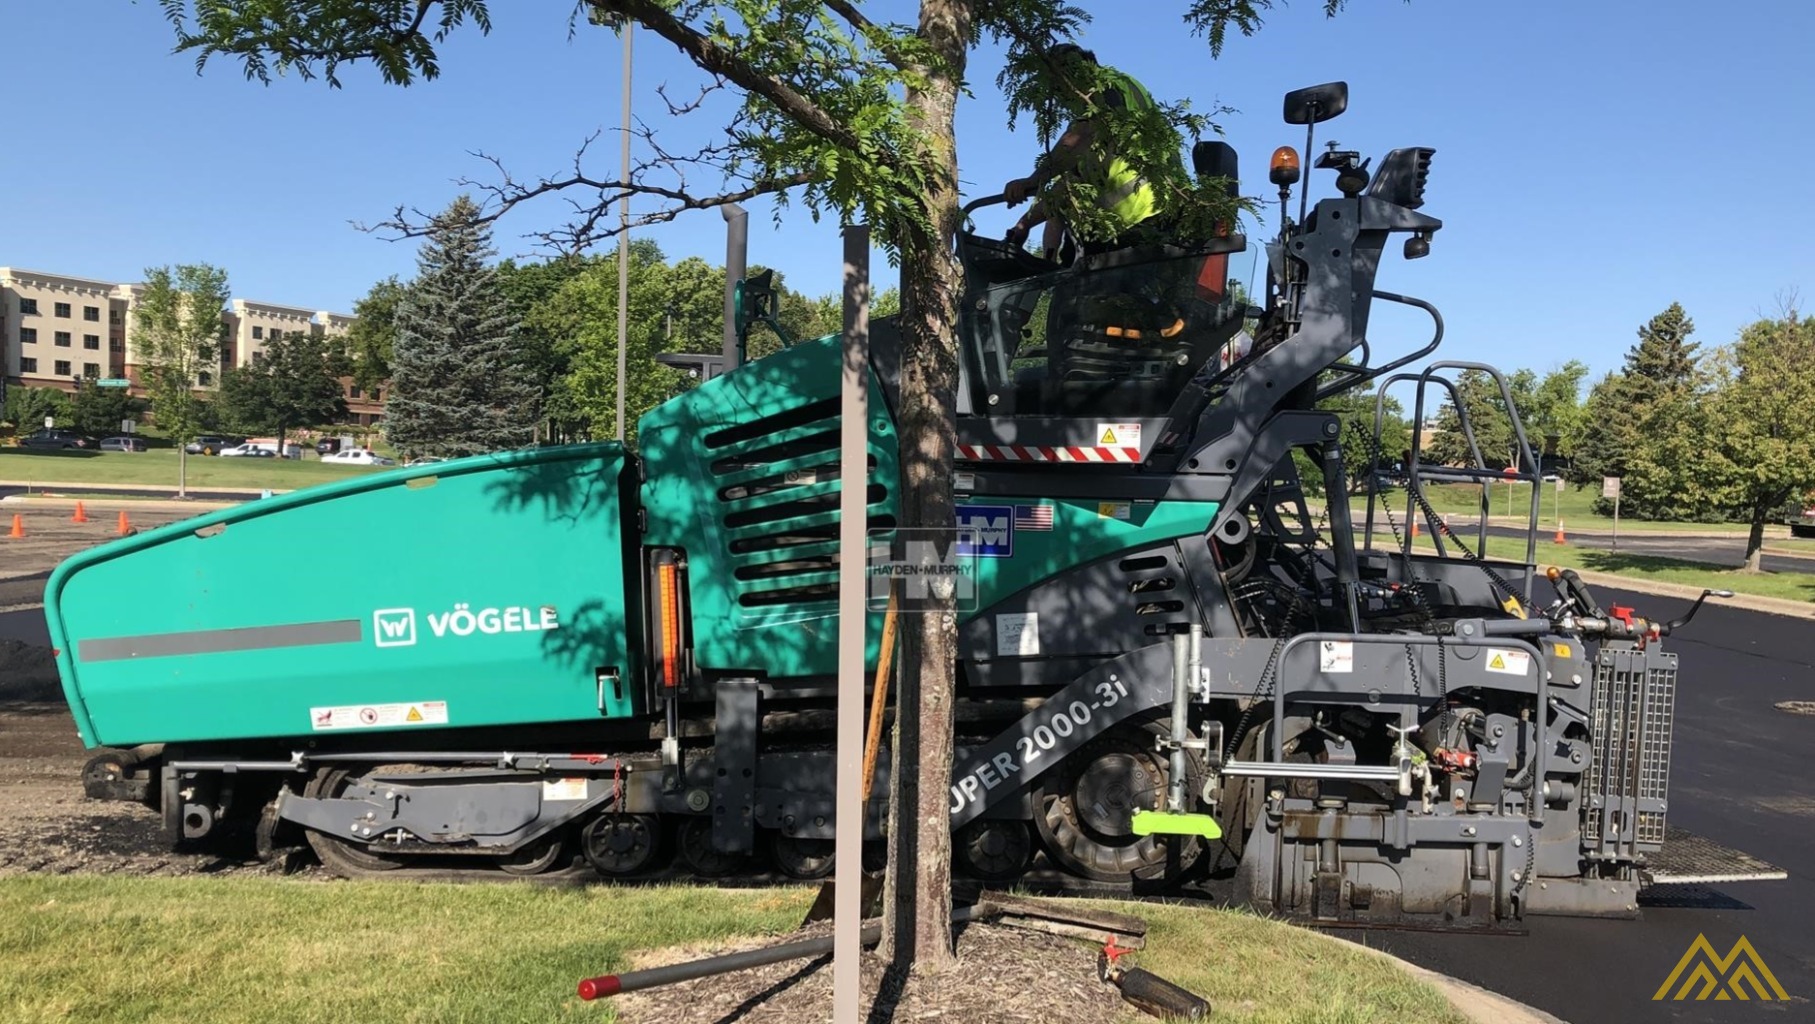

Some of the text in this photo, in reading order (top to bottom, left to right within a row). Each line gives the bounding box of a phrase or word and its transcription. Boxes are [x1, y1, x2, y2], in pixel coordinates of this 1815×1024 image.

[427, 603, 559, 637] VÖGELE
[950, 674, 1129, 814] UPER 2000-3i
